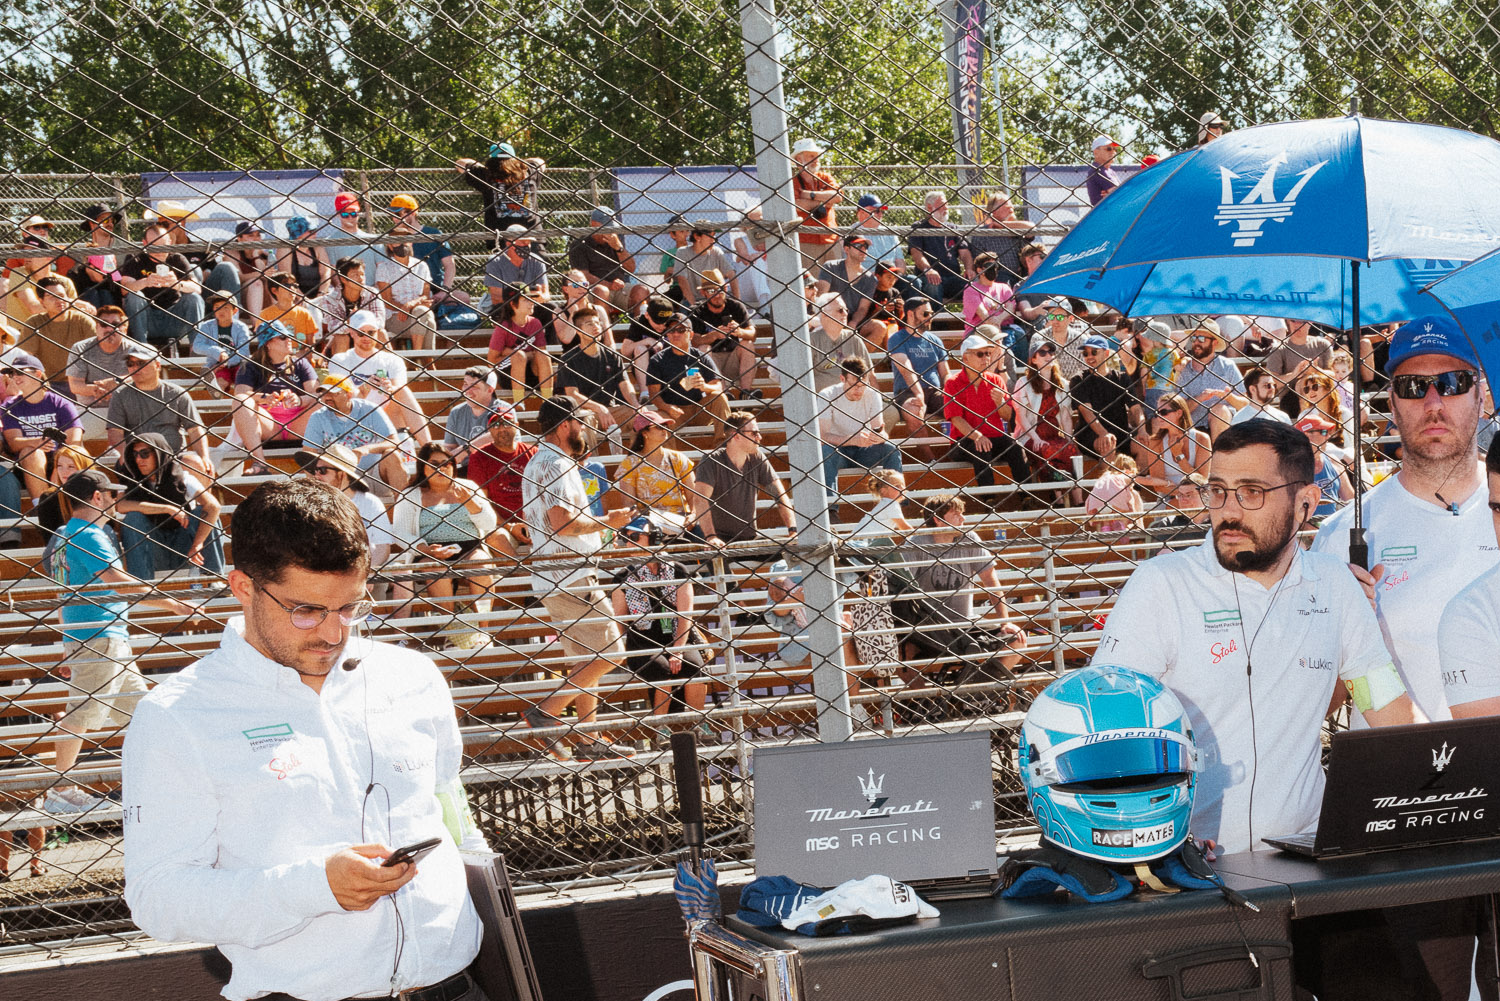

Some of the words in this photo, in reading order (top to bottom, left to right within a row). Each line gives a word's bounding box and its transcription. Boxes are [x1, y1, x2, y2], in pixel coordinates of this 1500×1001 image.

[1210, 639, 1238, 664] Stoli
[1081, 729, 1172, 745] Maserati
[1372, 787, 1488, 809] Maserati
[805, 800, 939, 822] Maserati
[1365, 819, 1396, 832] MSG
[1406, 808, 1485, 828] RACING
[806, 836, 839, 852] MSG
[852, 826, 941, 847] RACING
